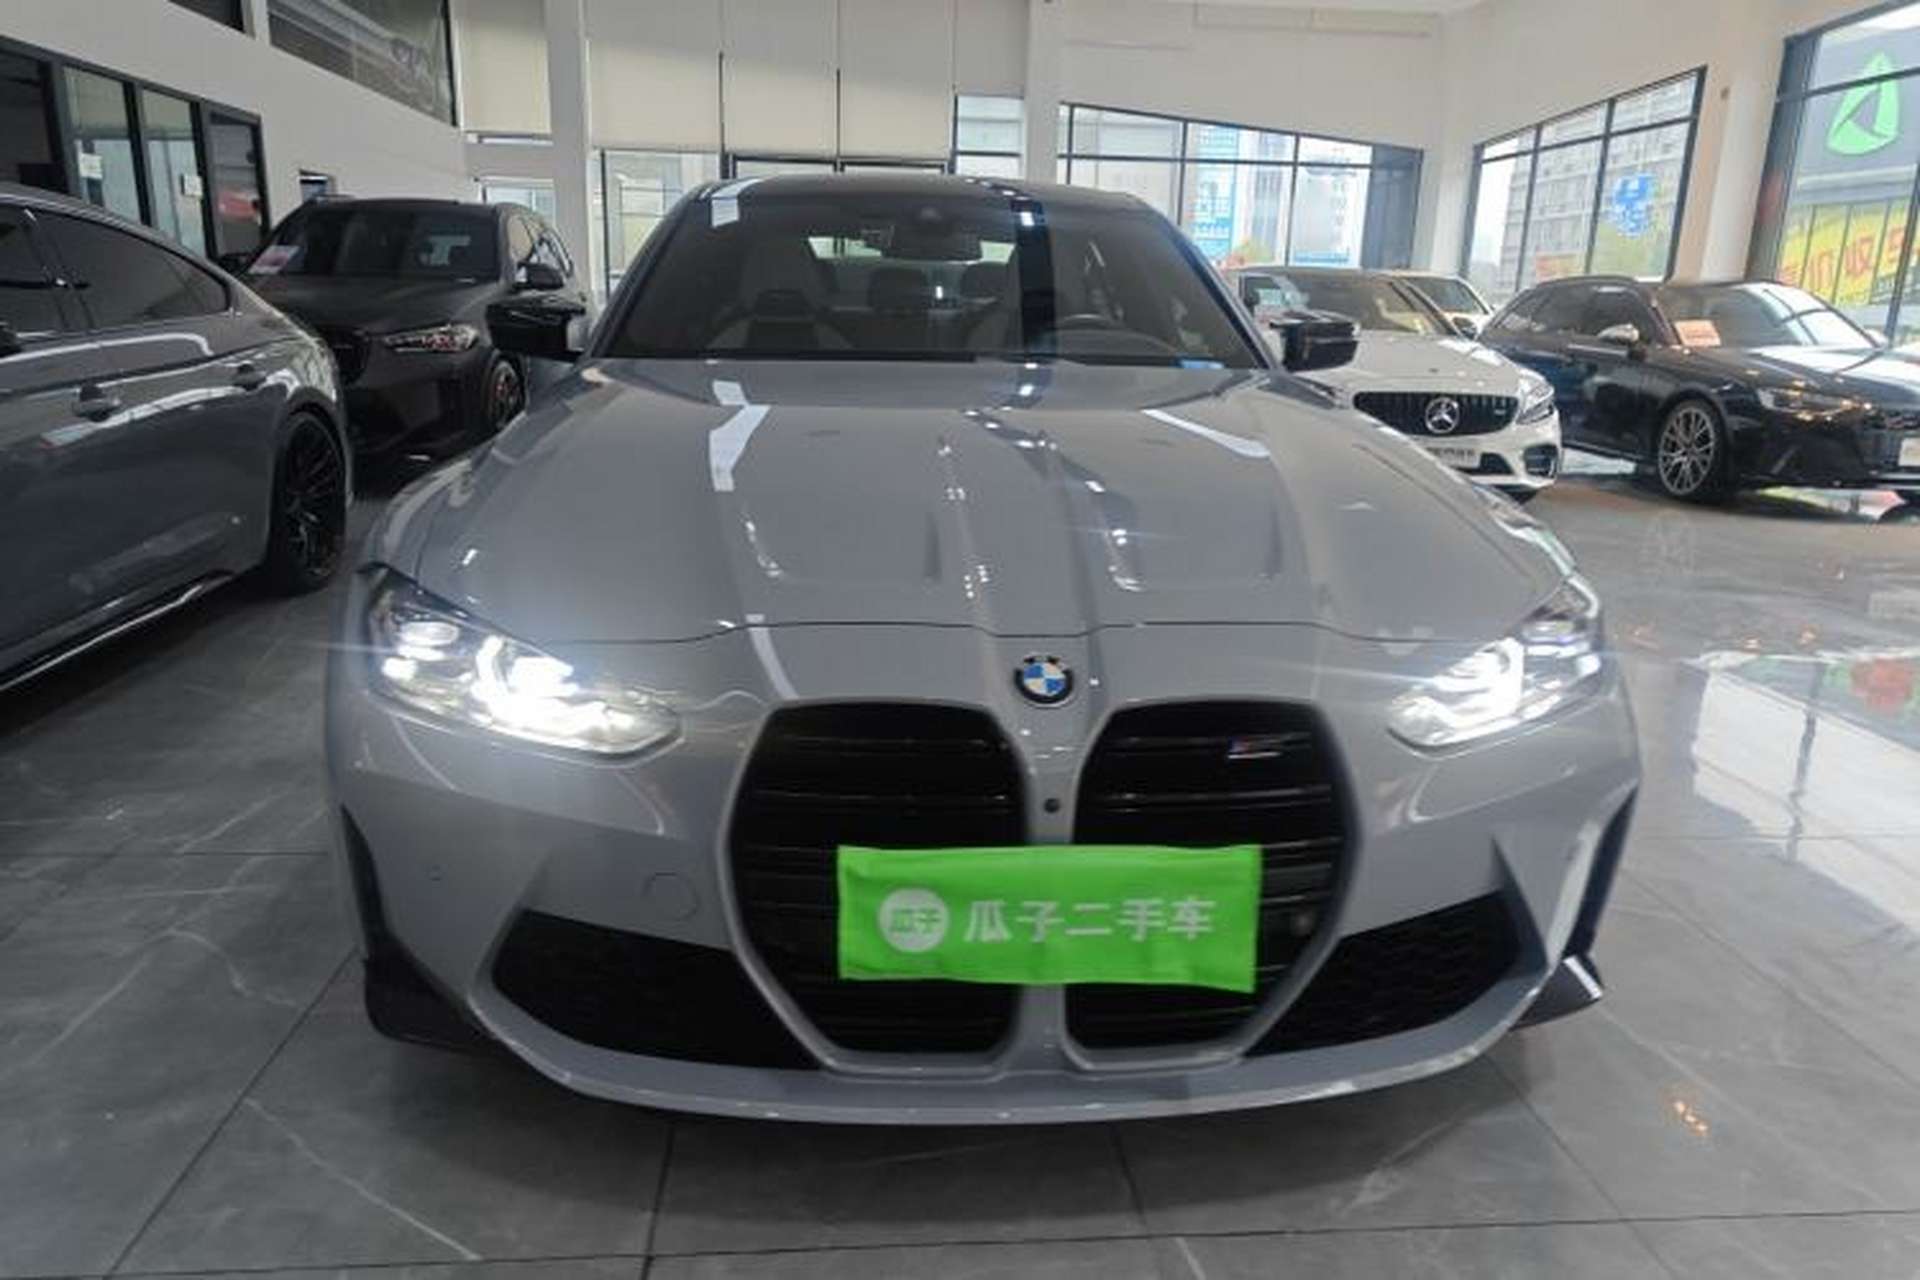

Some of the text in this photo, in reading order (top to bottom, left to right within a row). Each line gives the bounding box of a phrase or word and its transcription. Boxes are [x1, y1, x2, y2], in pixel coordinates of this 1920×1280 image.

[963, 899, 1215, 943] 瓜子二手车
